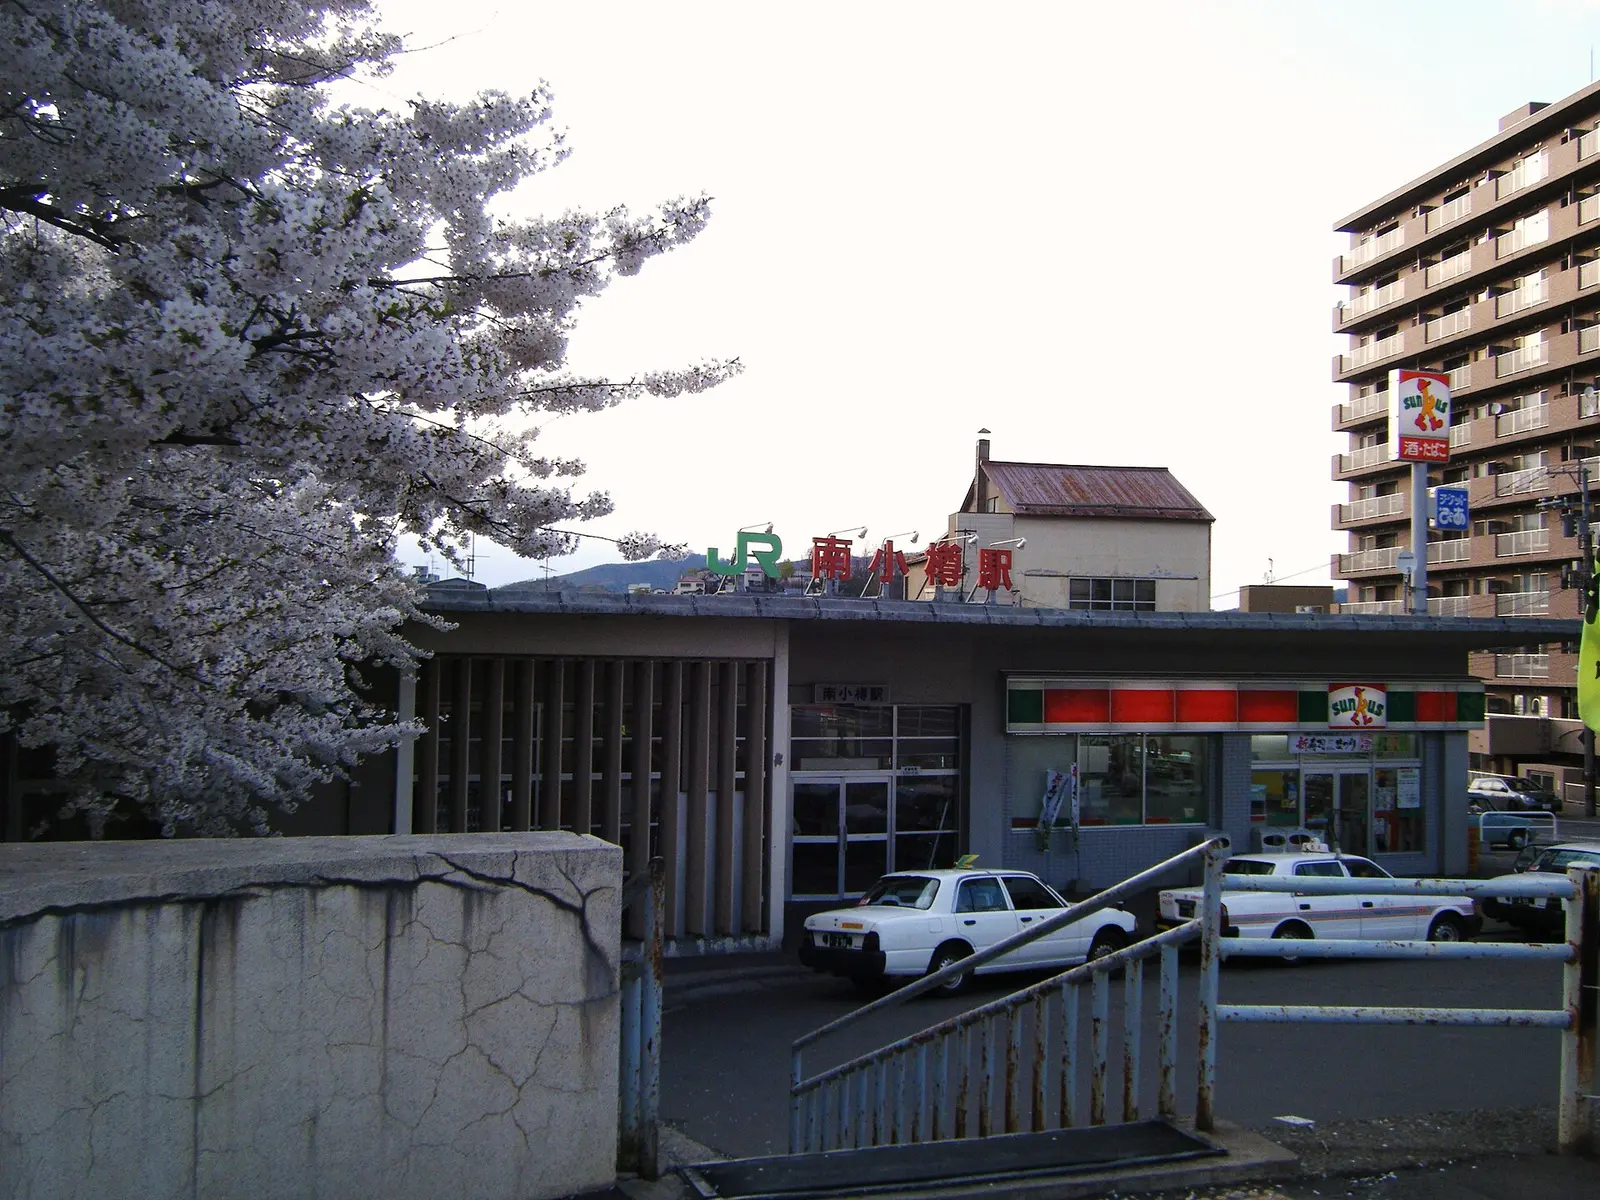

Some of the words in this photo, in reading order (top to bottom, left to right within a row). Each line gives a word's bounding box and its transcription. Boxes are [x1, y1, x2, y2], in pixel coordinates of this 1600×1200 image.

[1404, 440, 1447, 457] 酒・たばこ
[1438, 507, 1466, 526] ぴあ
[706, 531, 782, 578] JR
[811, 535, 1013, 591] 南小樽駅
